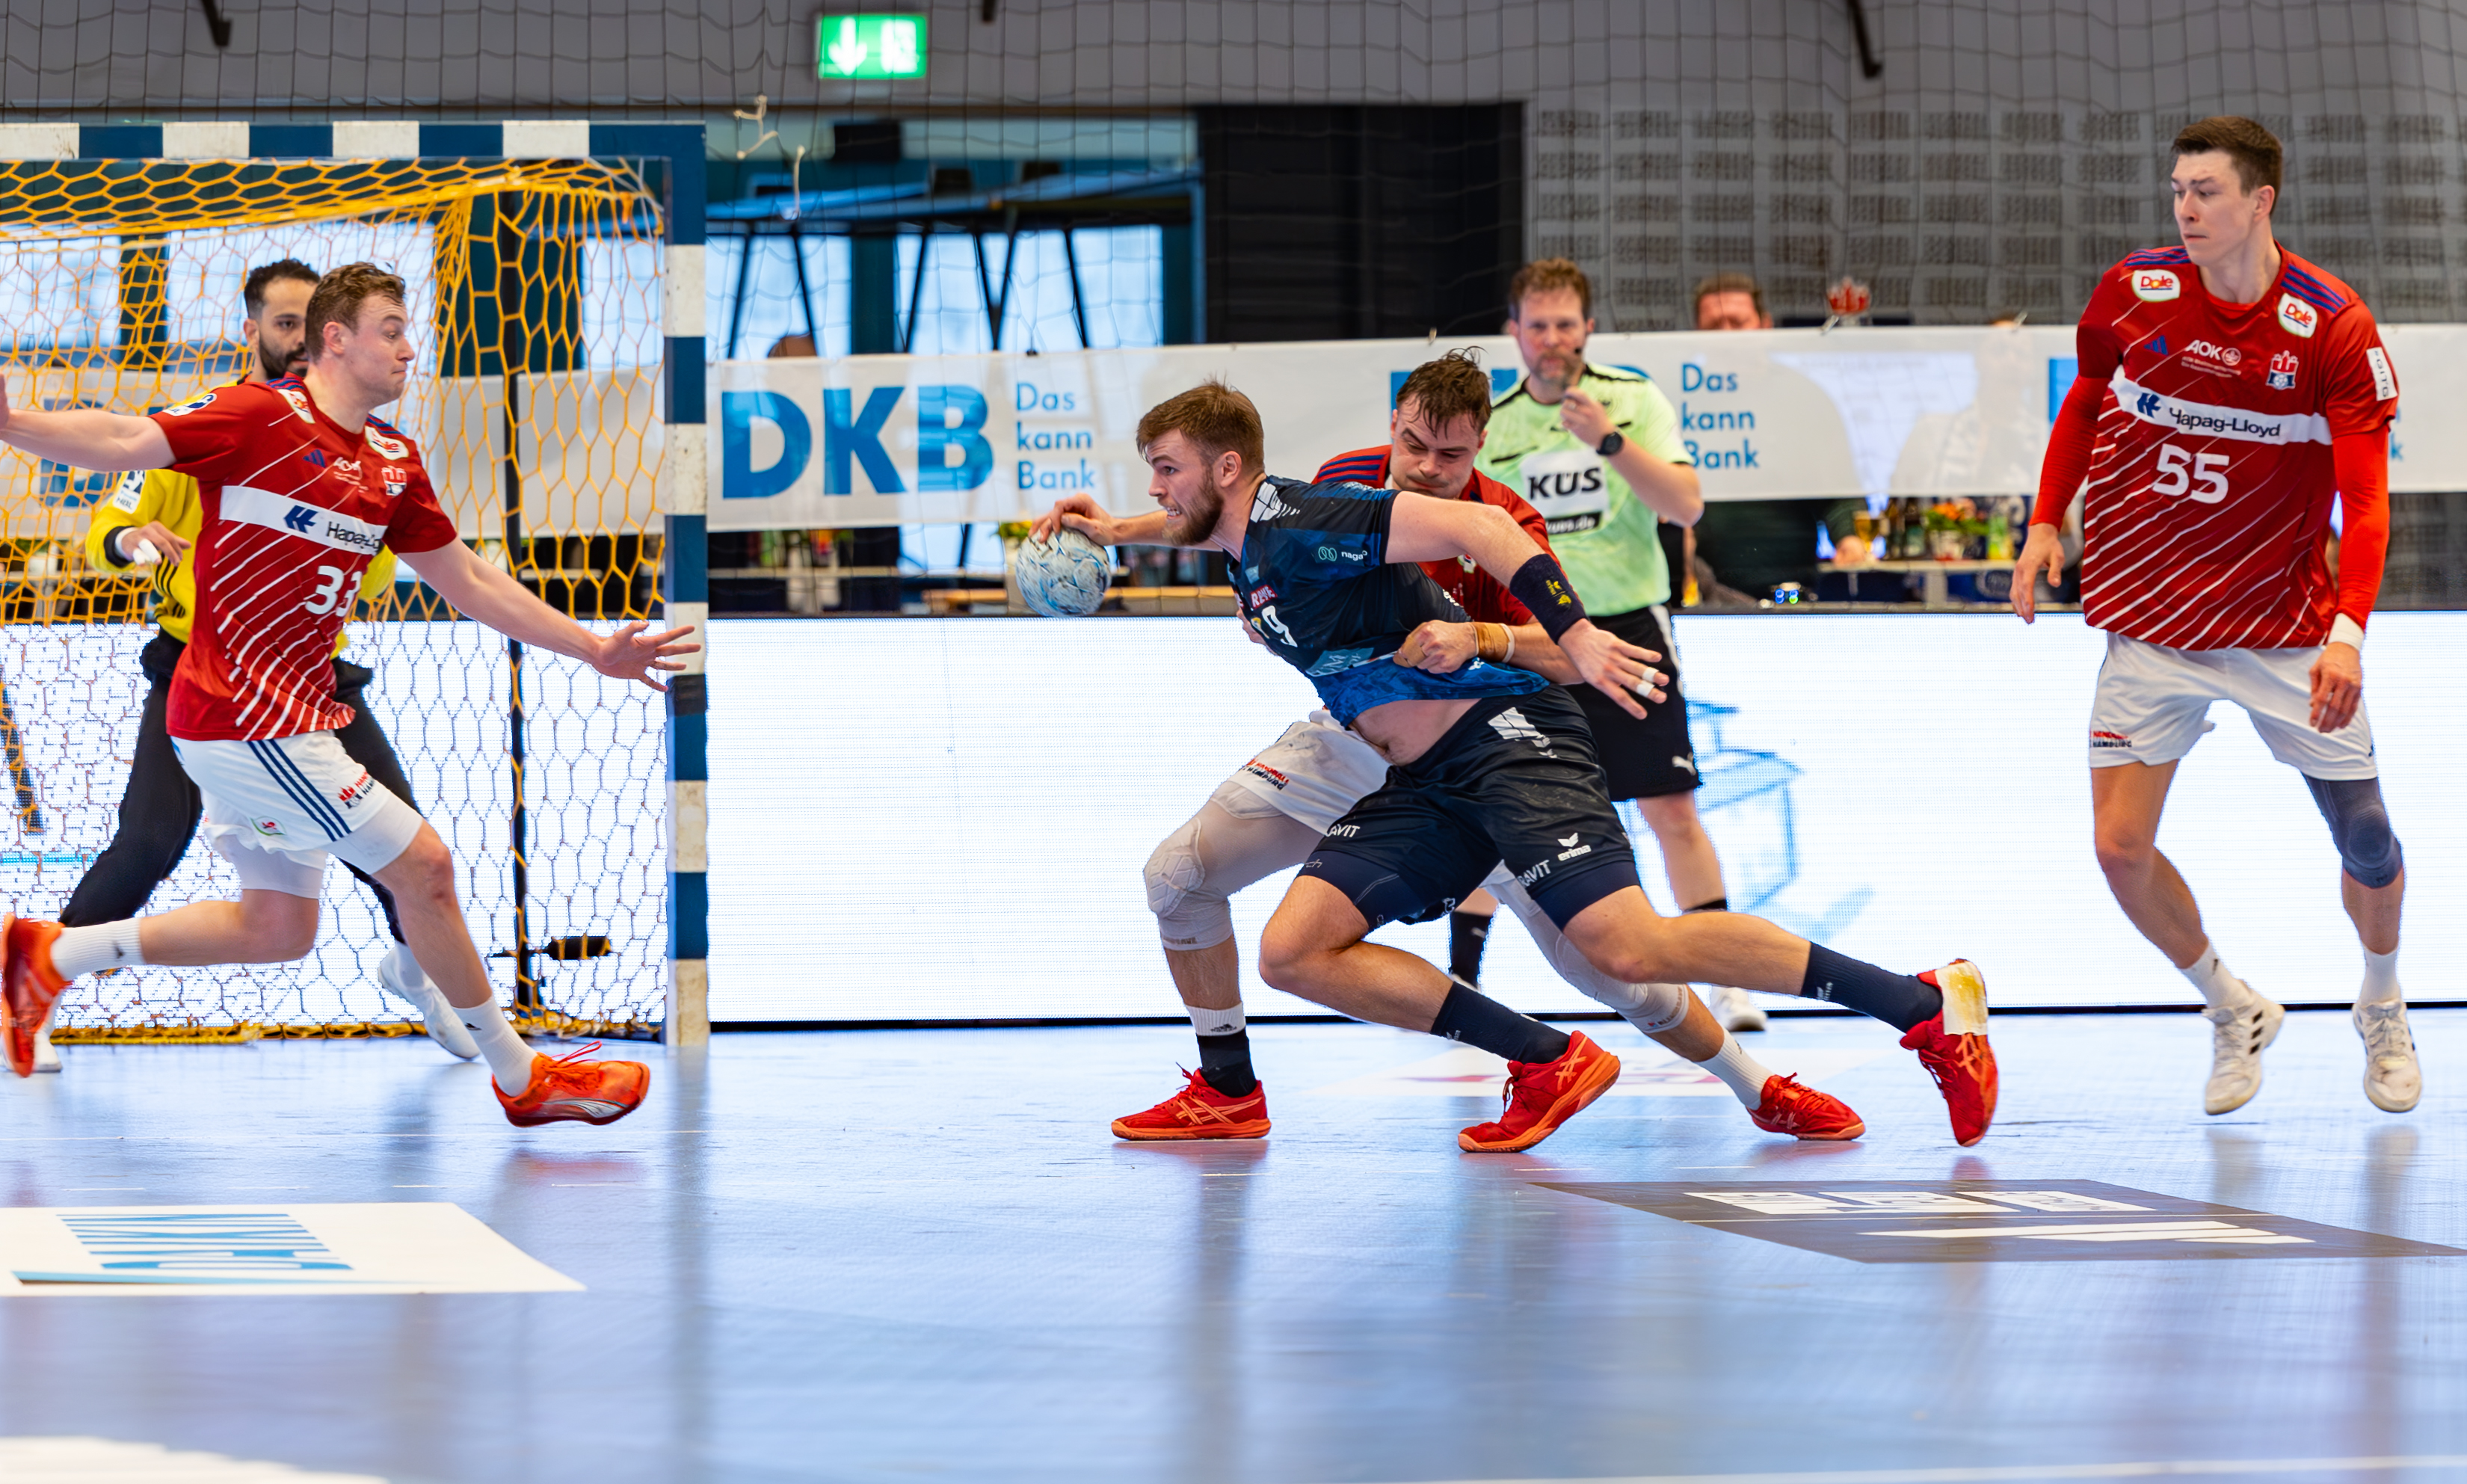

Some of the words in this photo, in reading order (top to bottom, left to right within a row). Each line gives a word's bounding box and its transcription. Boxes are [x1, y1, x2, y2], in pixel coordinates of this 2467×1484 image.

[2140, 275, 2173, 289] Dole
[2285, 303, 2312, 325] Dole
[2184, 339, 2223, 360] AOK
[1681, 363, 1738, 392] Das
[1016, 382, 1076, 411] Das
[1681, 401, 1755, 431] kann
[2169, 407, 2281, 438] Hapag-Lloyd
[721, 384, 994, 499] DKB
[1016, 420, 1093, 451] kann
[1684, 438, 1761, 469] Bank
[1017, 459, 1096, 490] Bank
[1528, 467, 1601, 500] KÜS
[2152, 443, 2230, 504] 55
[305, 565, 363, 618] 33
[1557, 845, 1592, 861] erima
